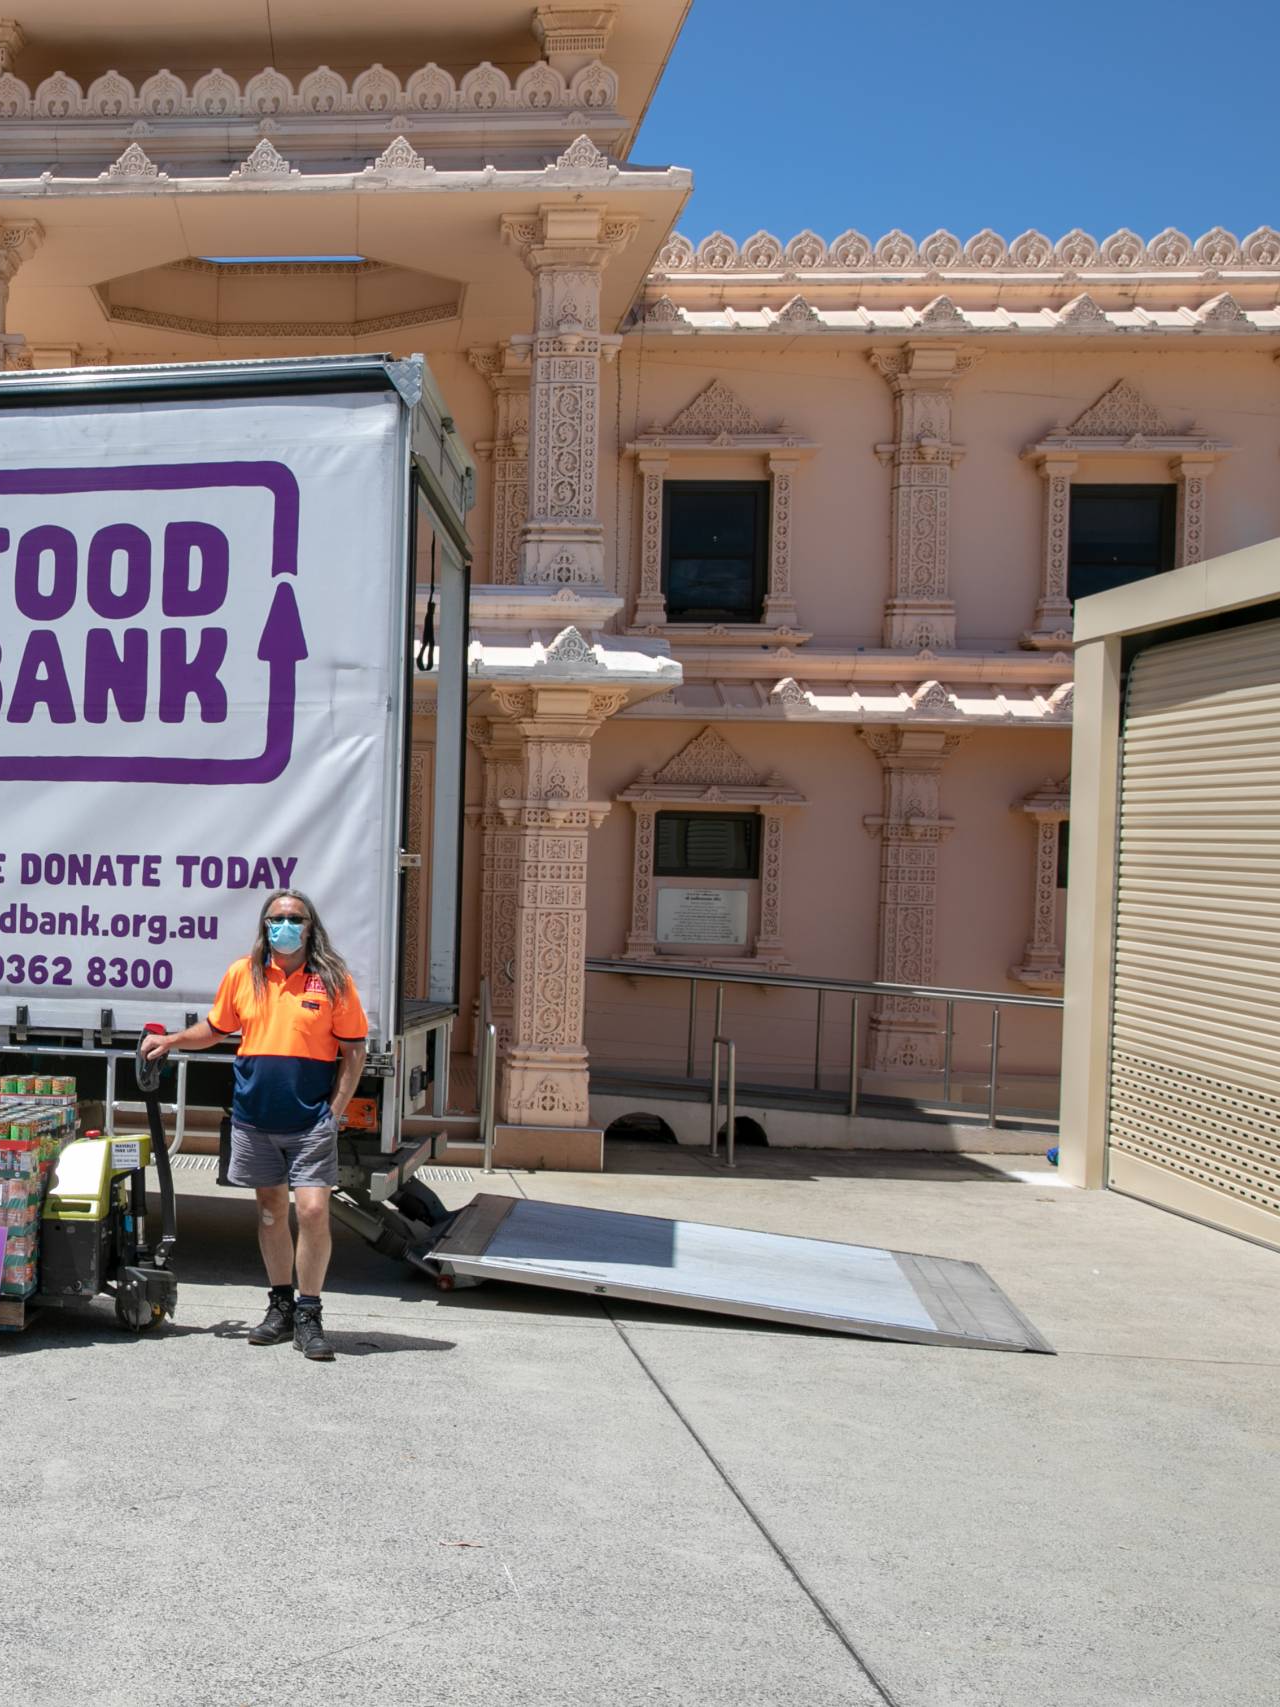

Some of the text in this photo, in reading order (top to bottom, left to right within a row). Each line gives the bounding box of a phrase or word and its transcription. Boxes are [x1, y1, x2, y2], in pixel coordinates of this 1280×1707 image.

[21, 854, 161, 886] DONATE
[176, 856, 297, 889] TODAY
[87, 957, 172, 989] 8300
